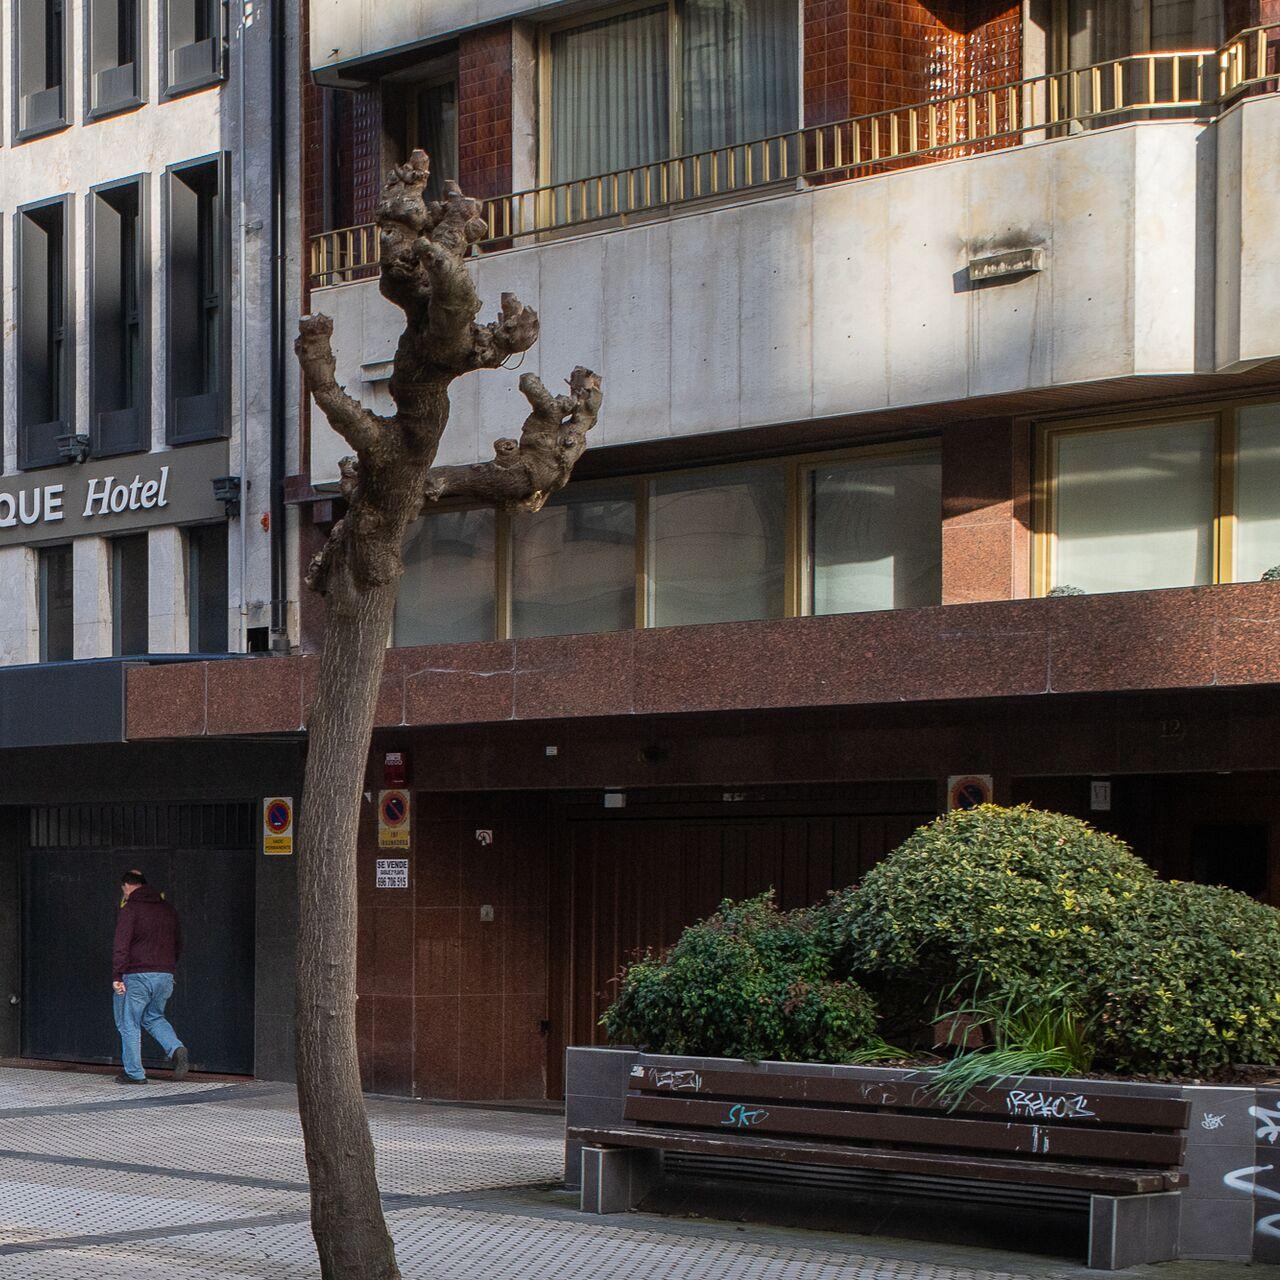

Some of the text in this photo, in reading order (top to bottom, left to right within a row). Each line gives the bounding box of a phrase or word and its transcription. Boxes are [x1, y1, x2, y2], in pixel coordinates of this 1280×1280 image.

[82, 466, 169, 517] Hotel
[377, 861, 407, 869] SE VENDE
